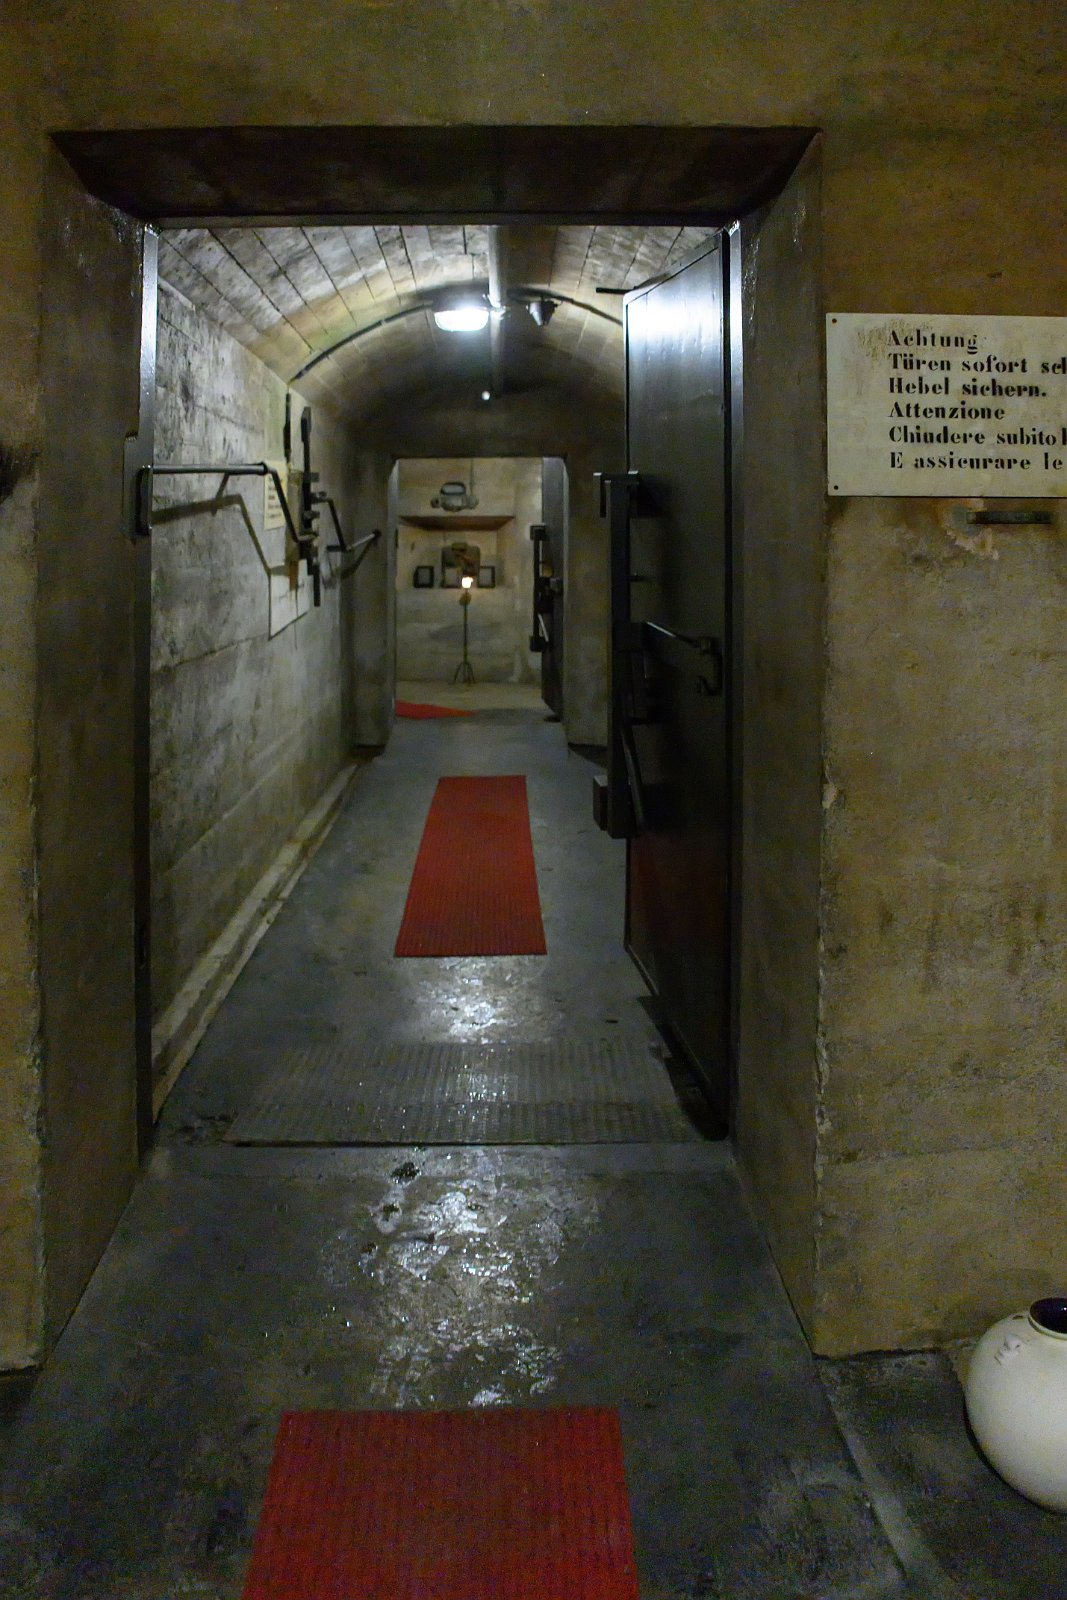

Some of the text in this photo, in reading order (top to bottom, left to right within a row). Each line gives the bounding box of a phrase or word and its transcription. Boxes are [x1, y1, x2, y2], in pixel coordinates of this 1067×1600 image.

[889, 330, 977, 354] Achtung
[889, 353, 951, 371] Türen
[962, 355, 1027, 373] sofort
[889, 377, 1046, 397] Hebel sichern.
[889, 401, 1005, 420] Attenzione
[889, 426, 985, 444] Chiudere
[997, 428, 1056, 446] subito
[891, 452, 1063, 470] E assicurare le
